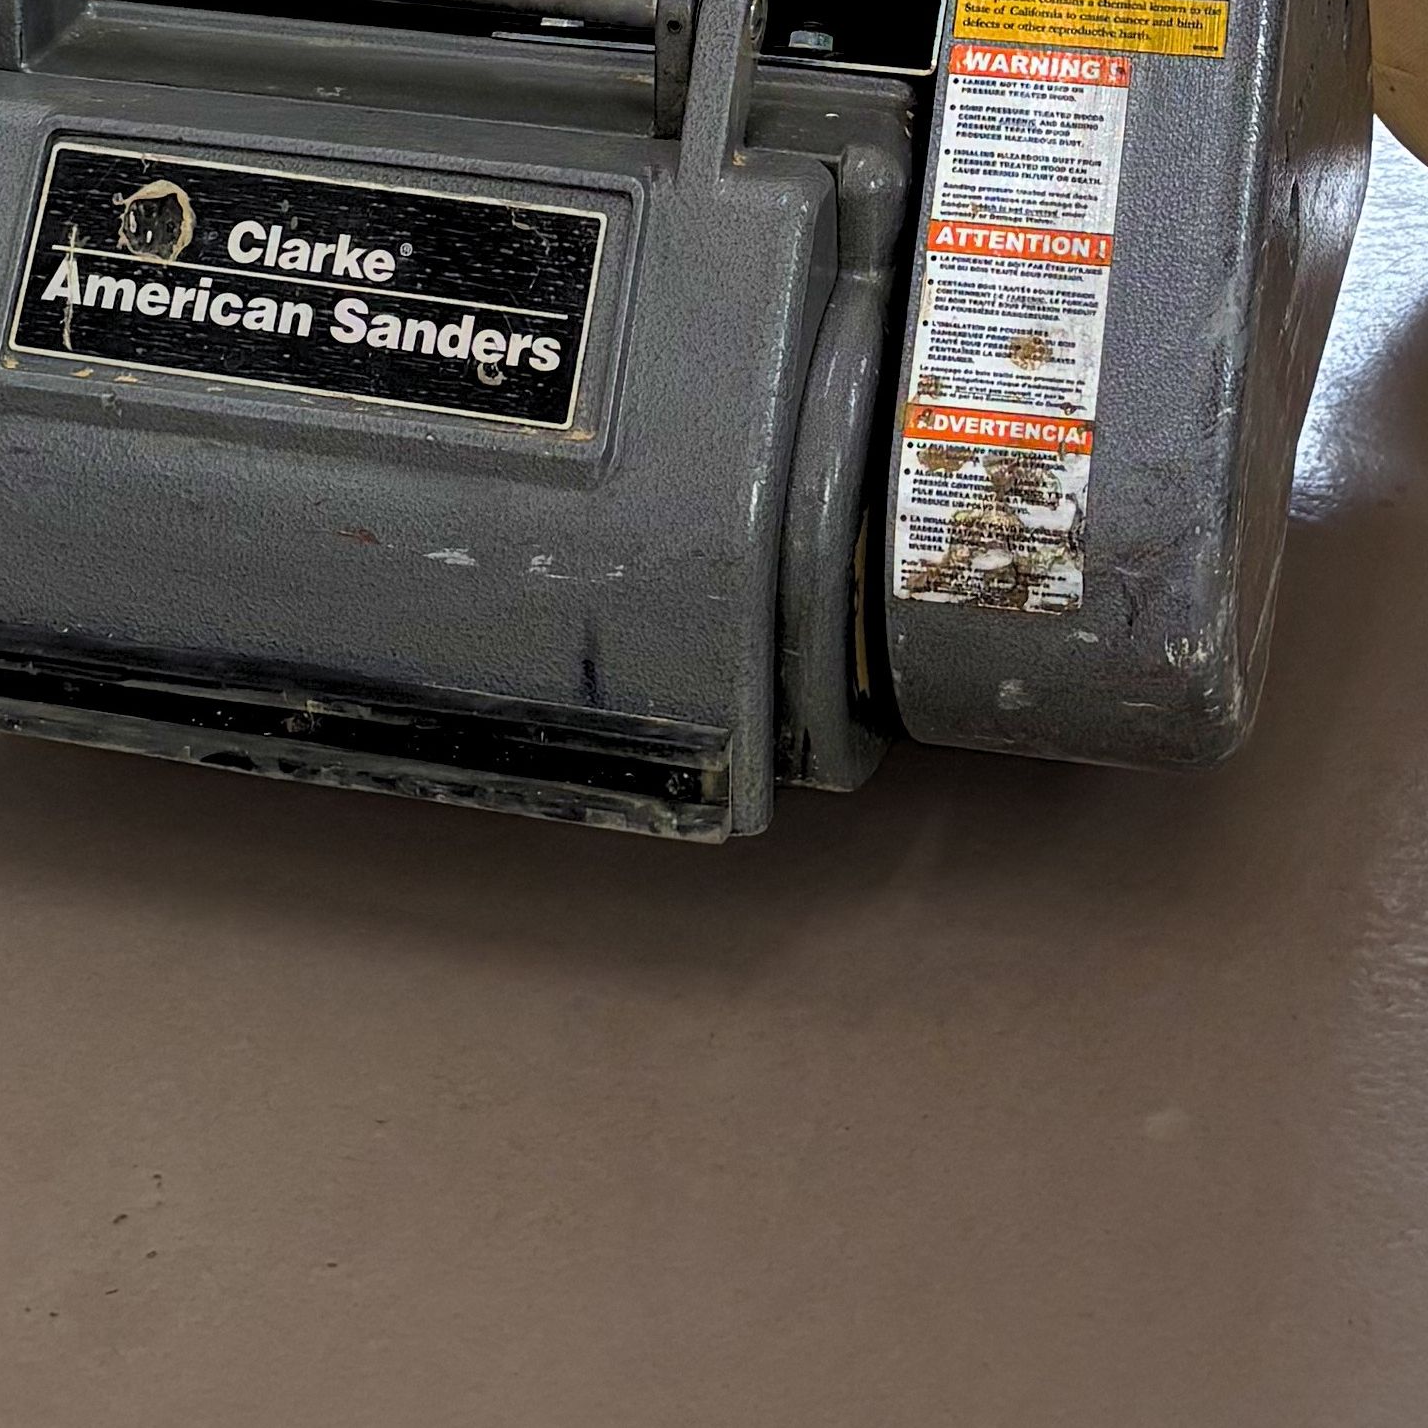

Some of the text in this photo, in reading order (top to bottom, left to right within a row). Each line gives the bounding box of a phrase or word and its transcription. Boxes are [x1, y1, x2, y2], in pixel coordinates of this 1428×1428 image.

[964, 2, 991, 13] State
[993, 4, 1005, 15] of
[1066, 12, 1077, 20] to
[965, 50, 1101, 80] WARNING
[935, 225, 1090, 258] ATTENTION
[41, 257, 562, 372] American Sanders
